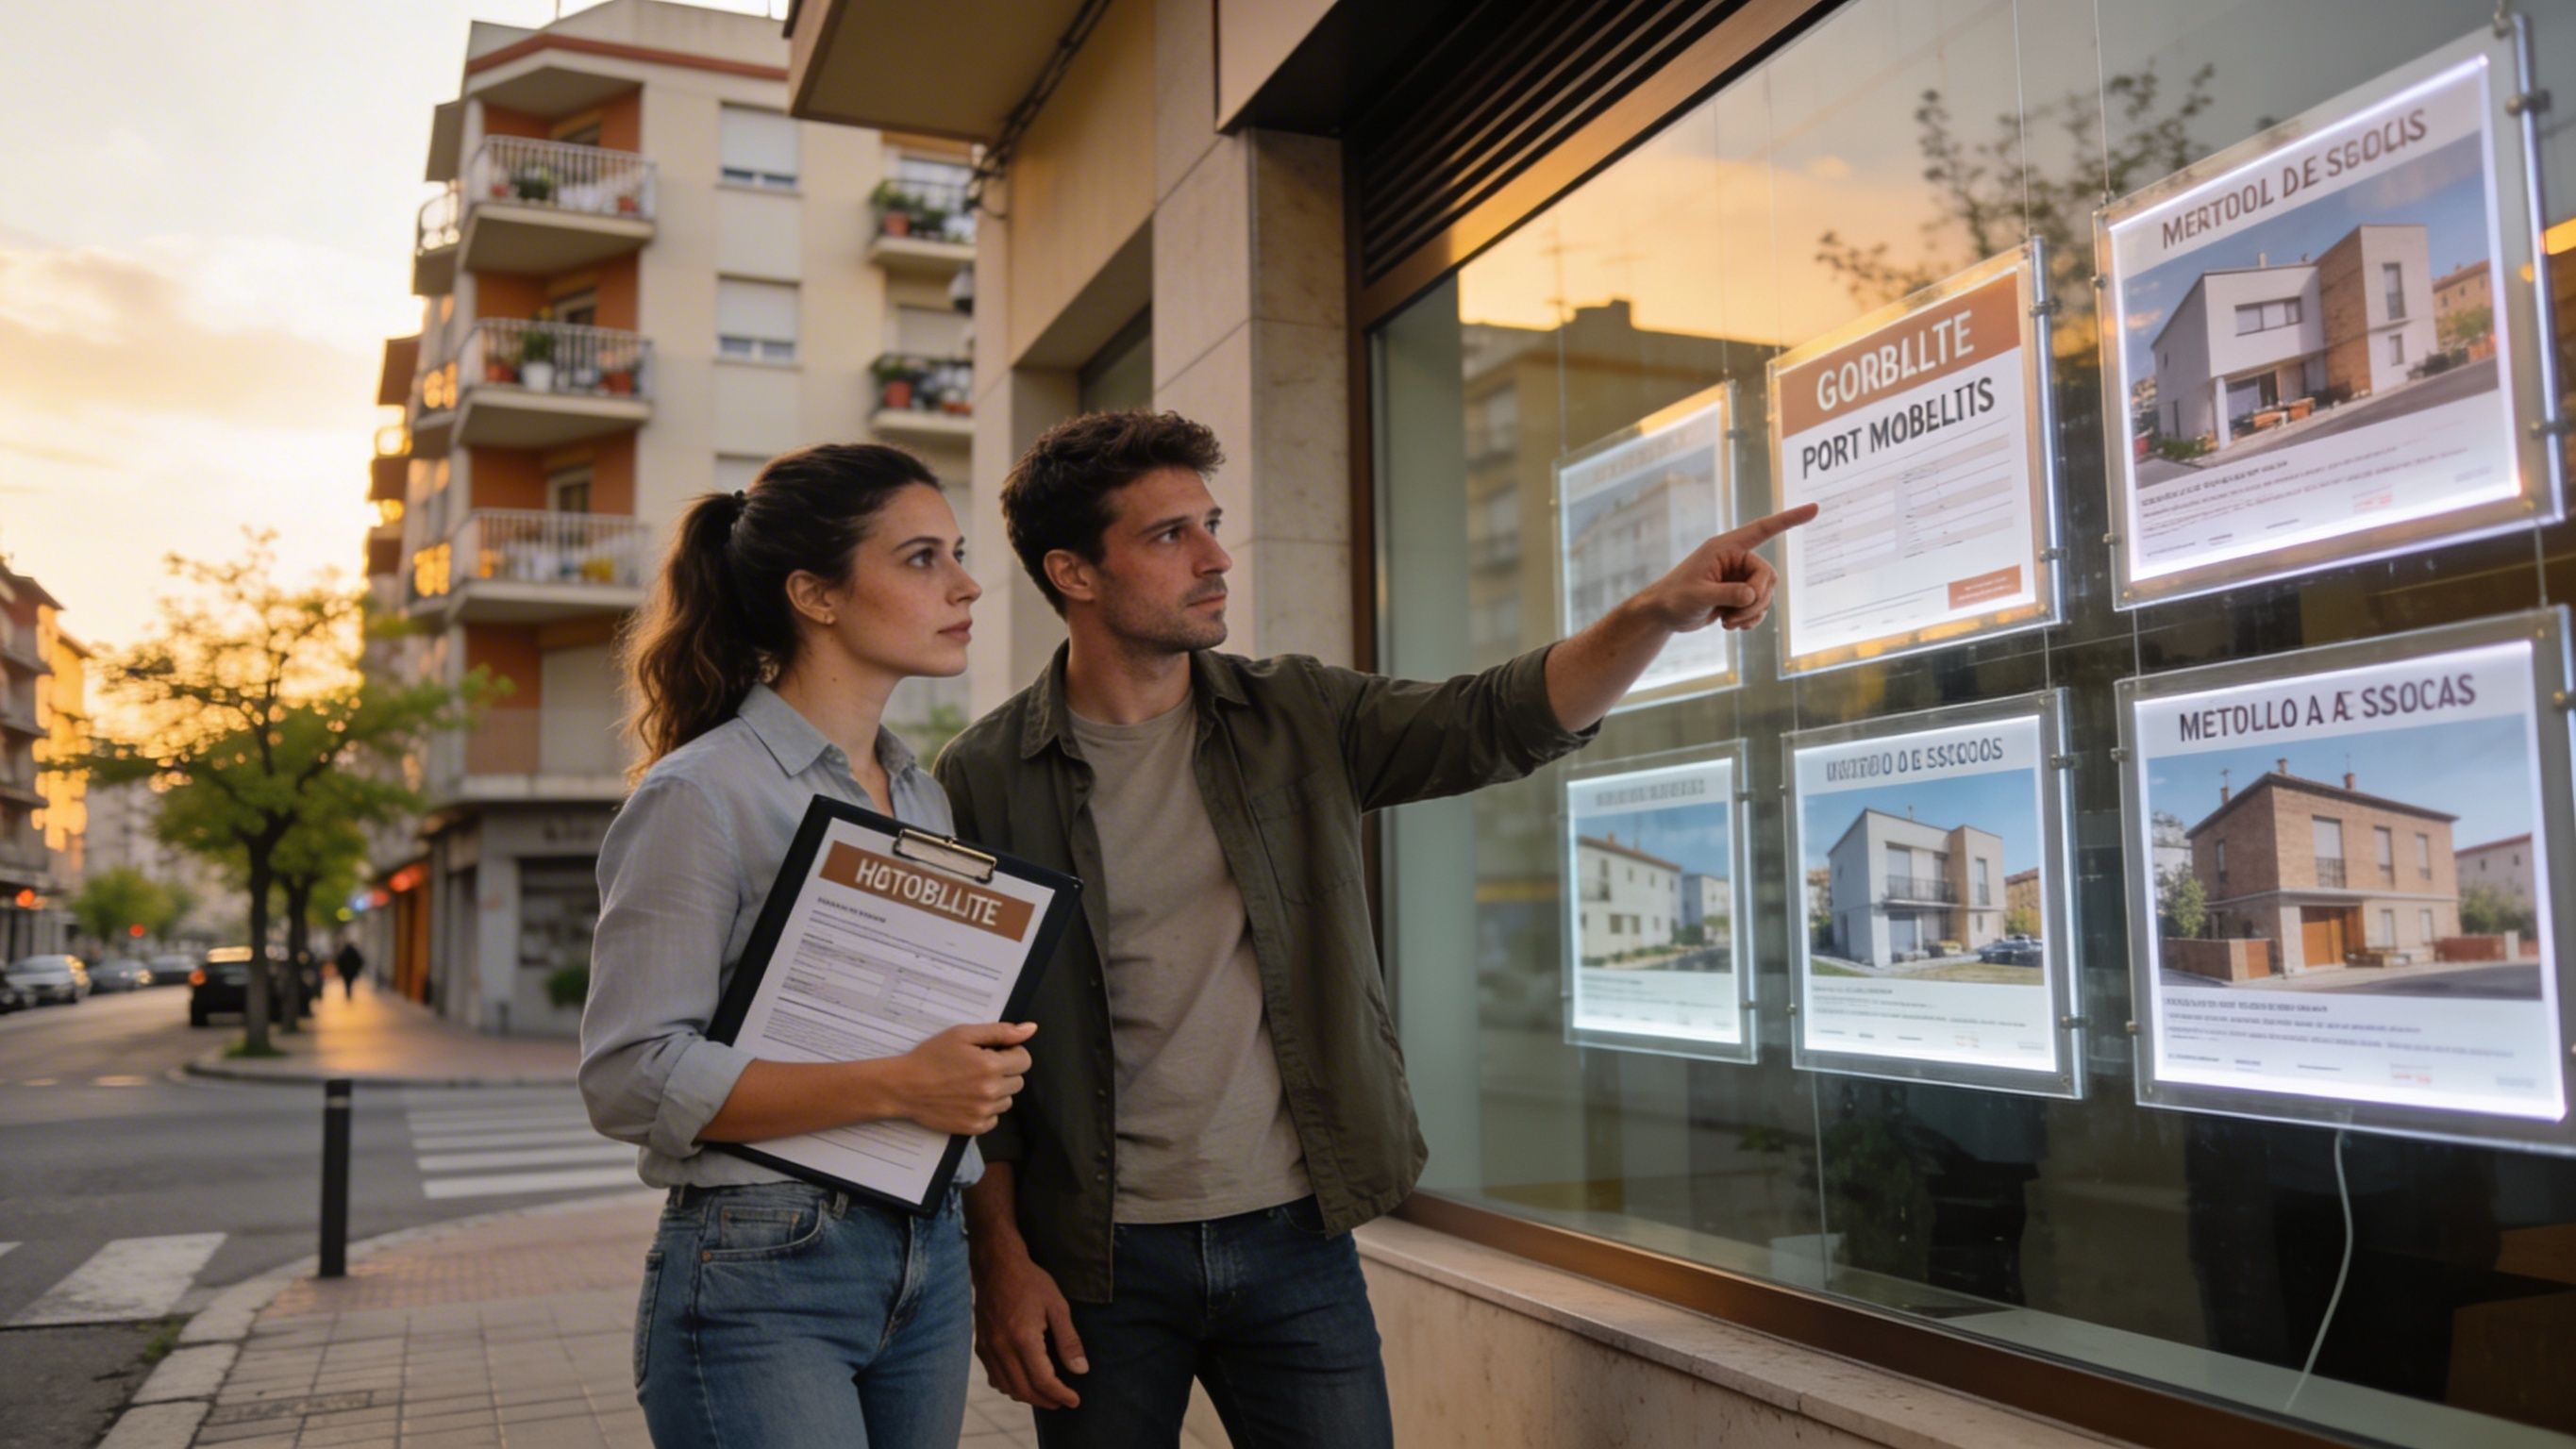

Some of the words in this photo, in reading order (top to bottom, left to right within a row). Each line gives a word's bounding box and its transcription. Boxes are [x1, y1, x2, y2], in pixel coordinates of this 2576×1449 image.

[2162, 177, 2275, 250] MERTOOL
[2282, 155, 2320, 198] DE
[1802, 427, 1863, 480] PORT
[2180, 699, 2298, 742] METOLLO
[2306, 694, 2325, 726] A
[2362, 674, 2476, 719] SSOCAS
